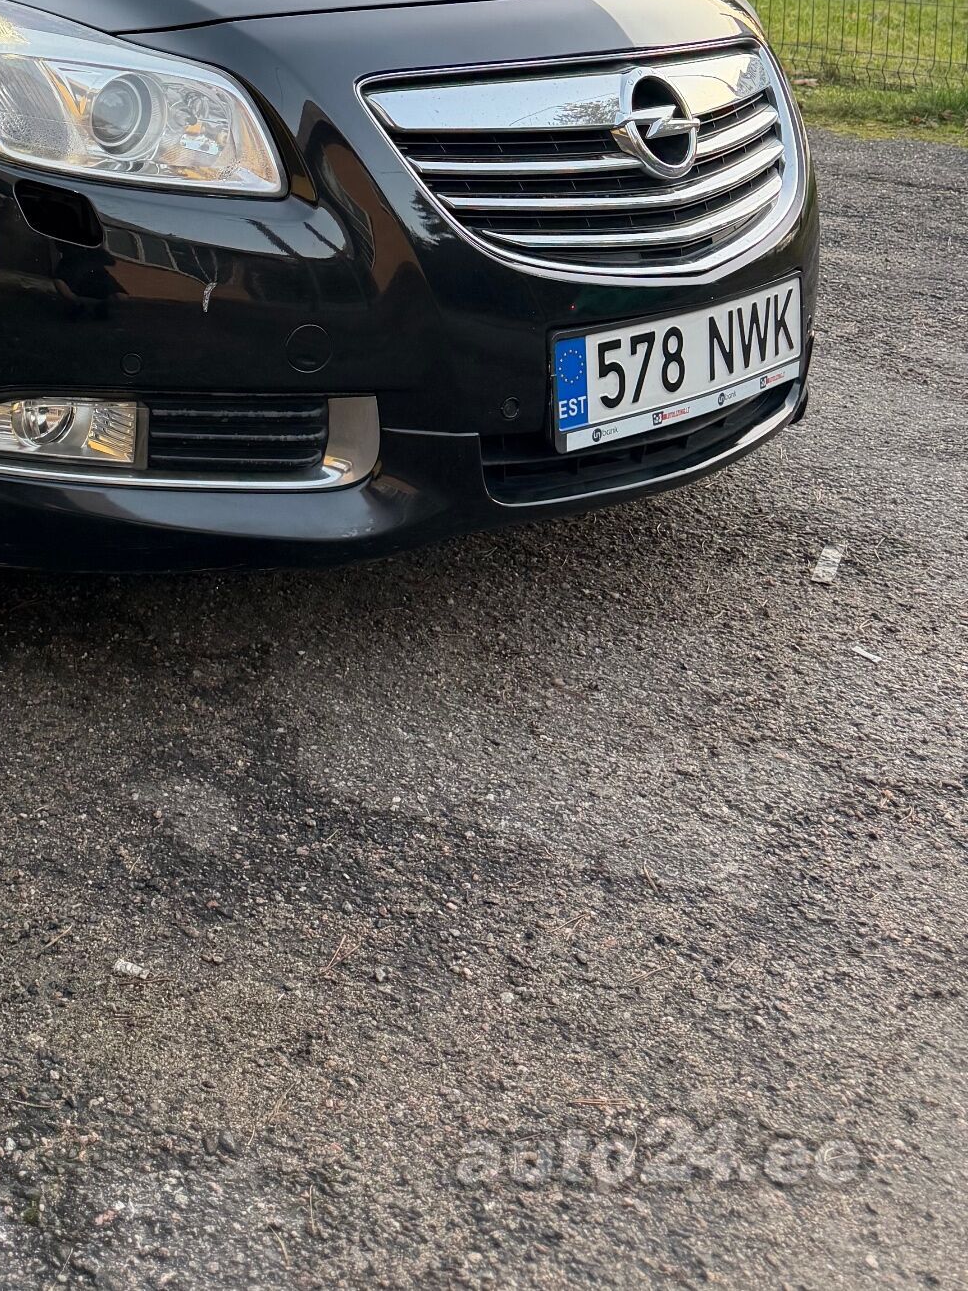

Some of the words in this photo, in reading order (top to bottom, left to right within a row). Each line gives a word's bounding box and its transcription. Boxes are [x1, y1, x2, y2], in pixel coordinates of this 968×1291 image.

[597, 326, 686, 409] 578
[708, 288, 794, 382] NWK
[558, 396, 587, 419] EST
